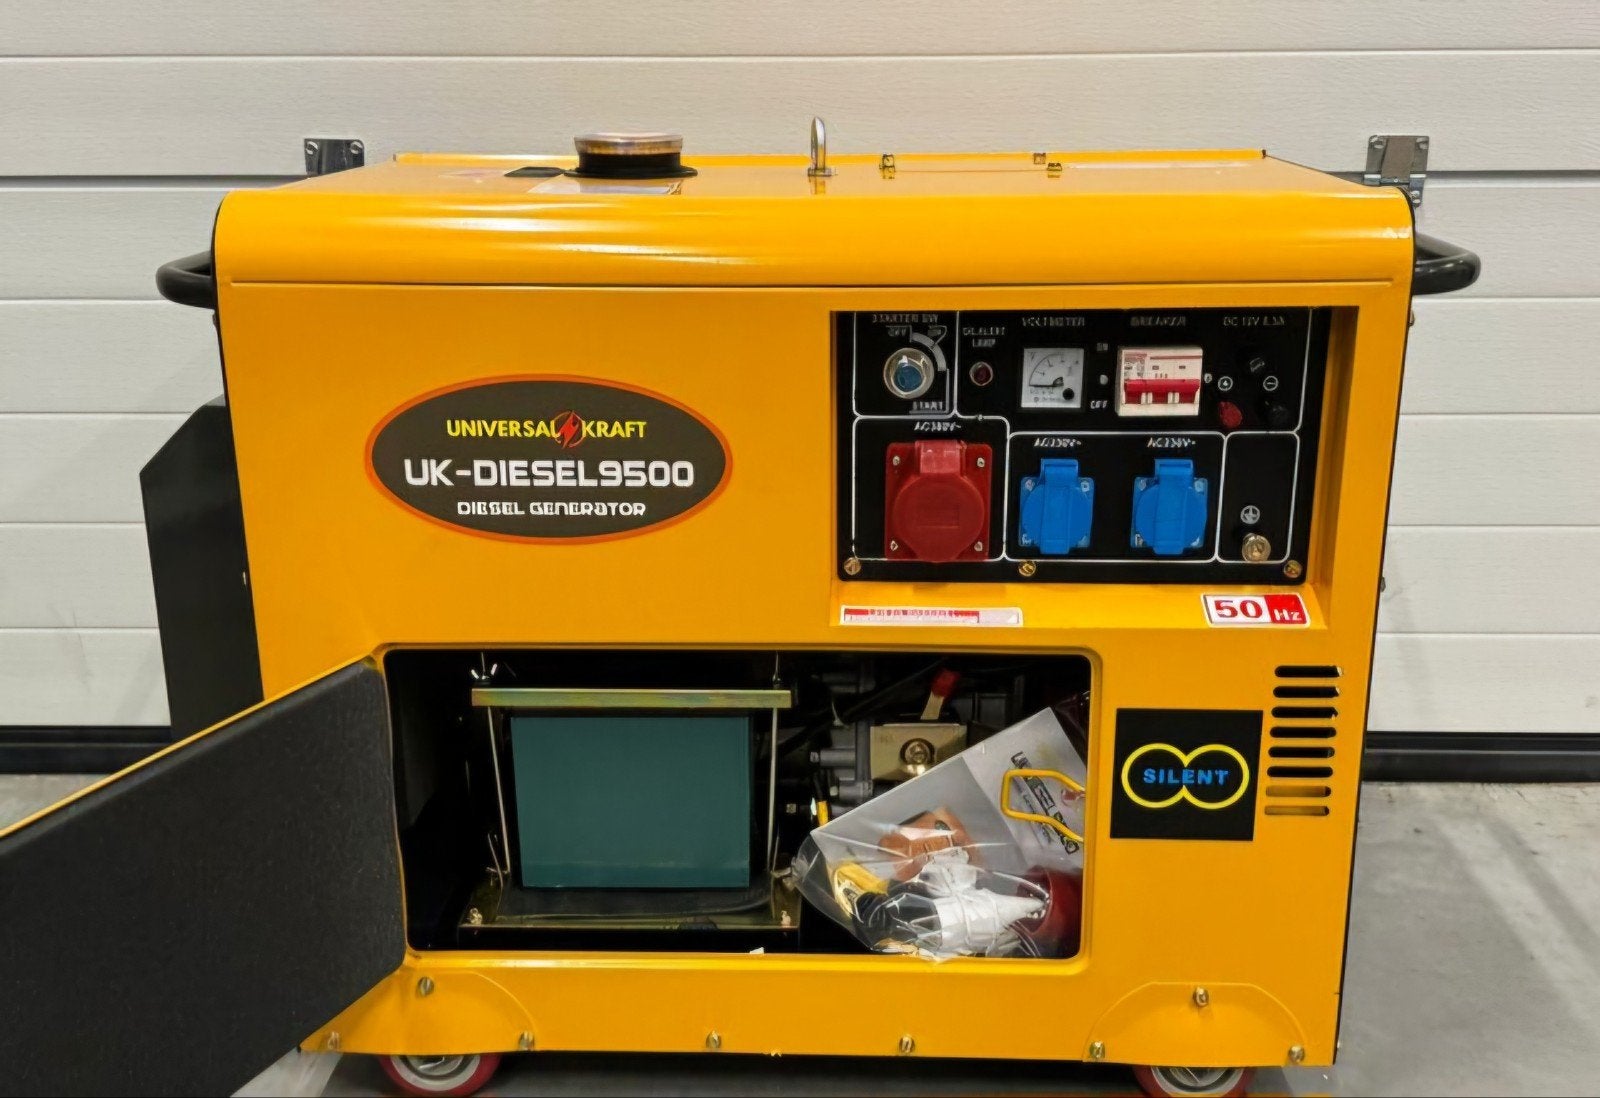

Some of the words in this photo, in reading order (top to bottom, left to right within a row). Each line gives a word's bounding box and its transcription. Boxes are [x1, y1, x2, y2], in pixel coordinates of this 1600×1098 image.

[446, 419, 558, 438] UNIVERSAL
[582, 420, 647, 438] KRAFT
[404, 458, 695, 487] UK-DIESEL9500
[457, 501, 525, 516] DIESEL
[529, 501, 647, 516] GENERATOR
[1213, 599, 1263, 619] 50
[1273, 609, 1302, 621] Hz
[1142, 768, 1230, 786] SILENT
